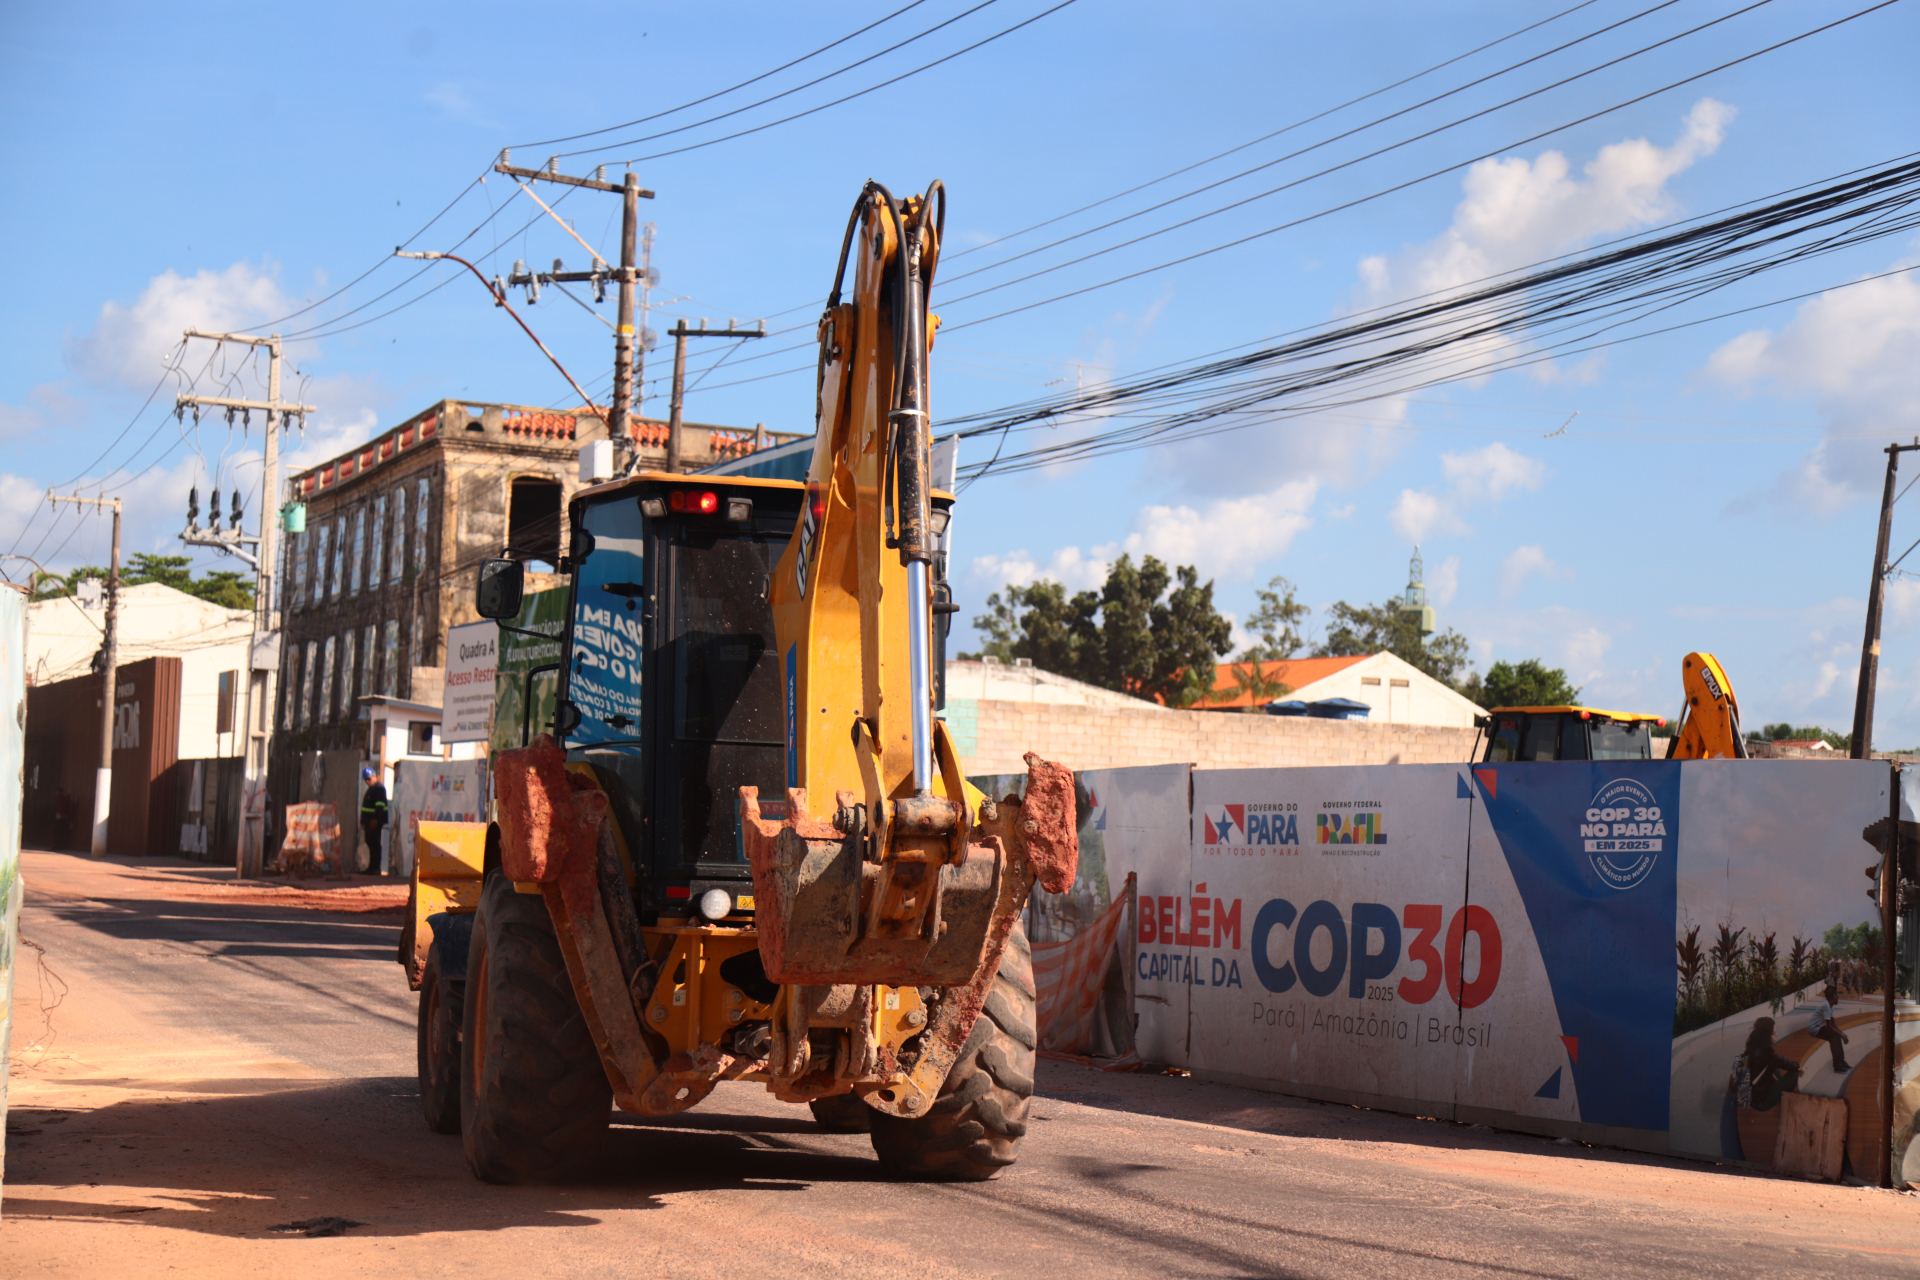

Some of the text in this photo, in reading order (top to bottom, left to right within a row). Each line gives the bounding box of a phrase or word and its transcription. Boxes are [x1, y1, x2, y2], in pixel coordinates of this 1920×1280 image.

[797, 494, 816, 598] CAT
[459, 639, 495, 663] Quadra A
[446, 667, 473, 687] Acesso
[1605, 786, 1625, 800] MAIOR
[1626, 785, 1648, 803] EVENTO
[1248, 803, 1298, 812] GOVERNO DO
[1322, 800, 1382, 809] GOVERNO FEDERAL
[1585, 806, 1661, 822] COP 30
[1247, 814, 1300, 845] PARÁ
[1316, 813, 1388, 845] BRASIL
[1580, 819, 1667, 837] NO PARÁ
[1203, 846, 1299, 857] POR TODO O PARÁ
[1340, 849, 1381, 858] RECONSTRUÇÃO
[1596, 841, 1650, 850] EM 2025
[1596, 857, 1650, 882] CLIMÁTICO DO MUNDO
[1138, 882, 1242, 950] BELÉM
[1251, 898, 1503, 1010] COP30
[1138, 952, 1243, 989] CAPITAL DA
[1367, 986, 1394, 1002] 2025
[1252, 1002, 1296, 1028] Pará
[1311, 1008, 1408, 1040] Amazônia
[1427, 1017, 1492, 1048] Brasil
